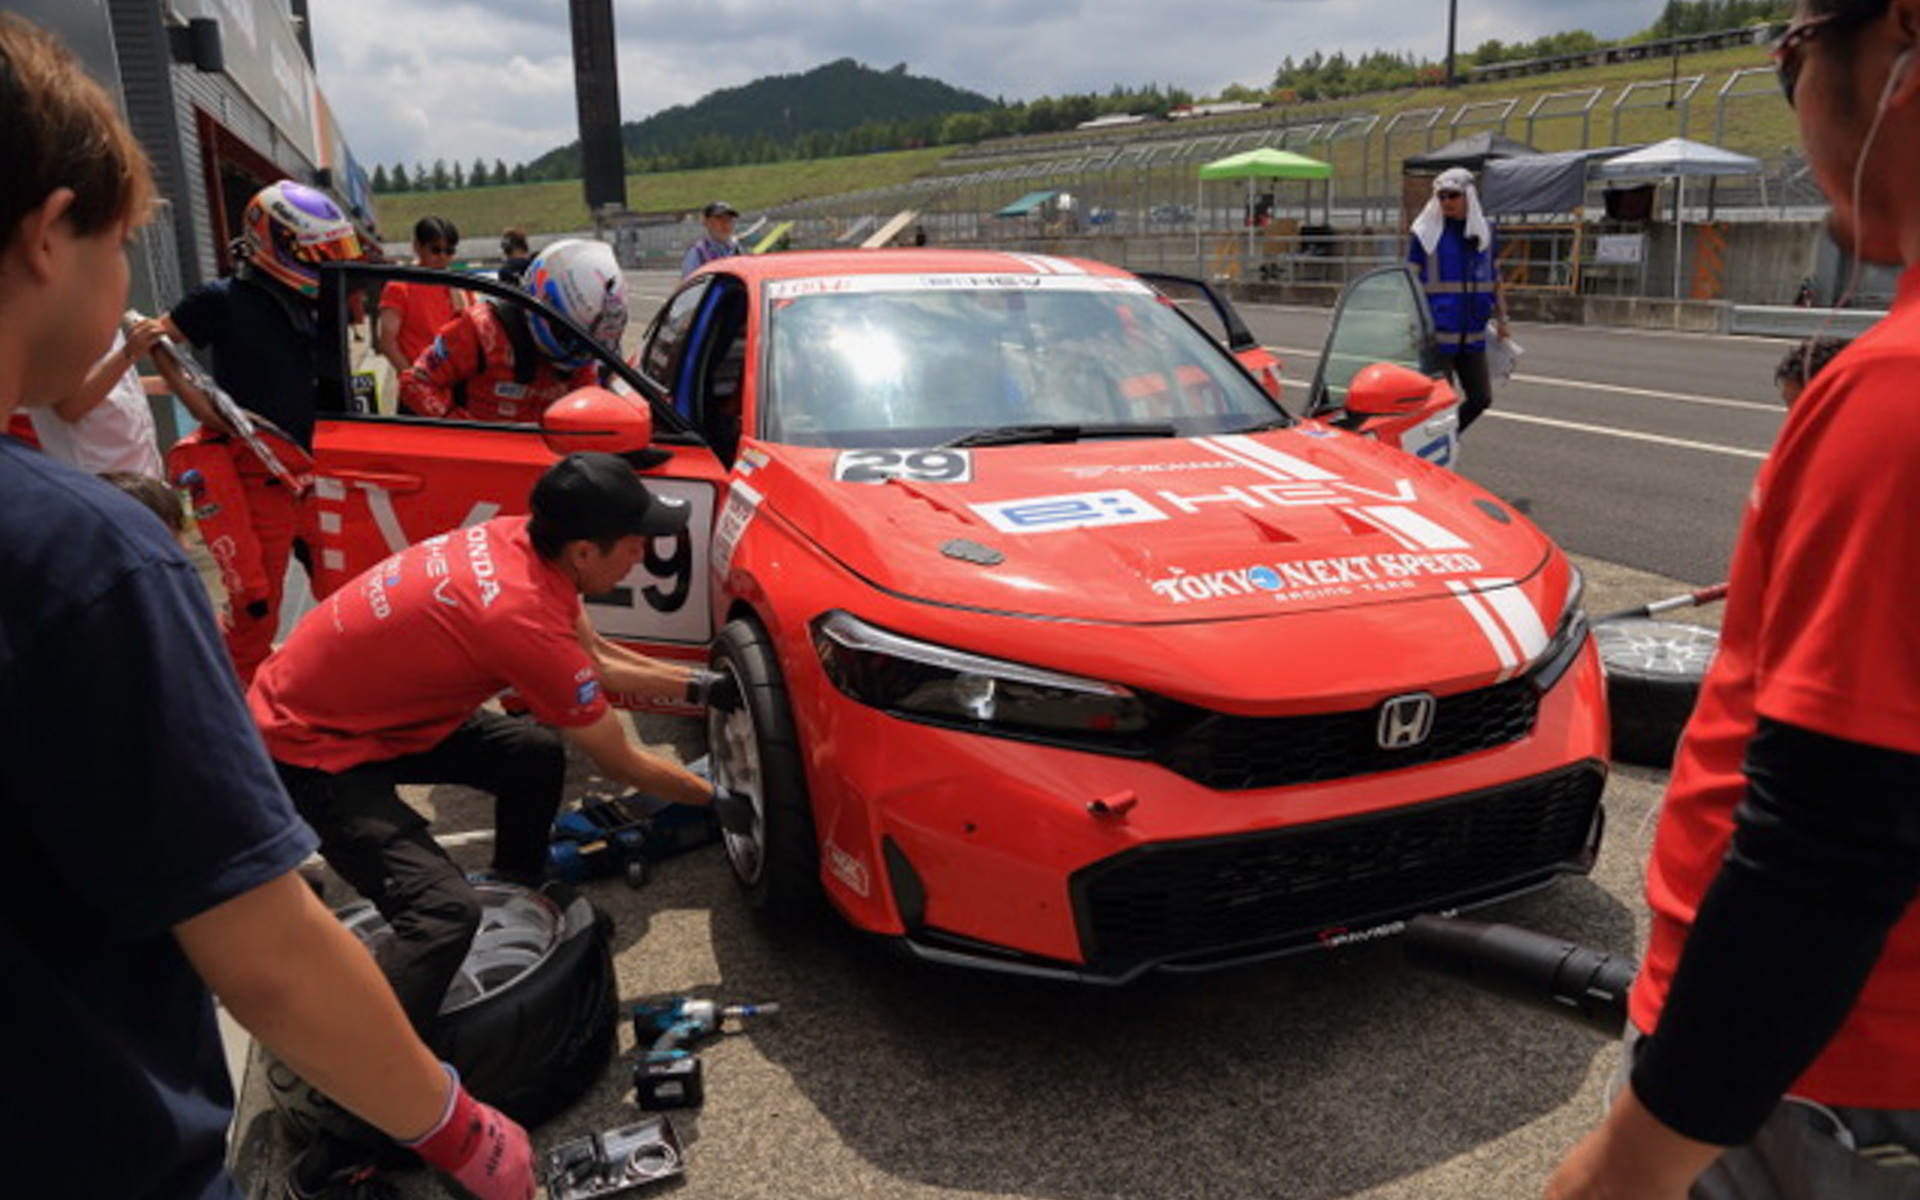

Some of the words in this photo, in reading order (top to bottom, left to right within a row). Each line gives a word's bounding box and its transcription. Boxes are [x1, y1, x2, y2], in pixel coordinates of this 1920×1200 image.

[842, 451, 966, 481] 29
[1157, 479, 1418, 513] HEV
[466, 525, 501, 608] ONDA
[1276, 556, 1374, 587] NEXT
[1374, 553, 1483, 579] SPEED
